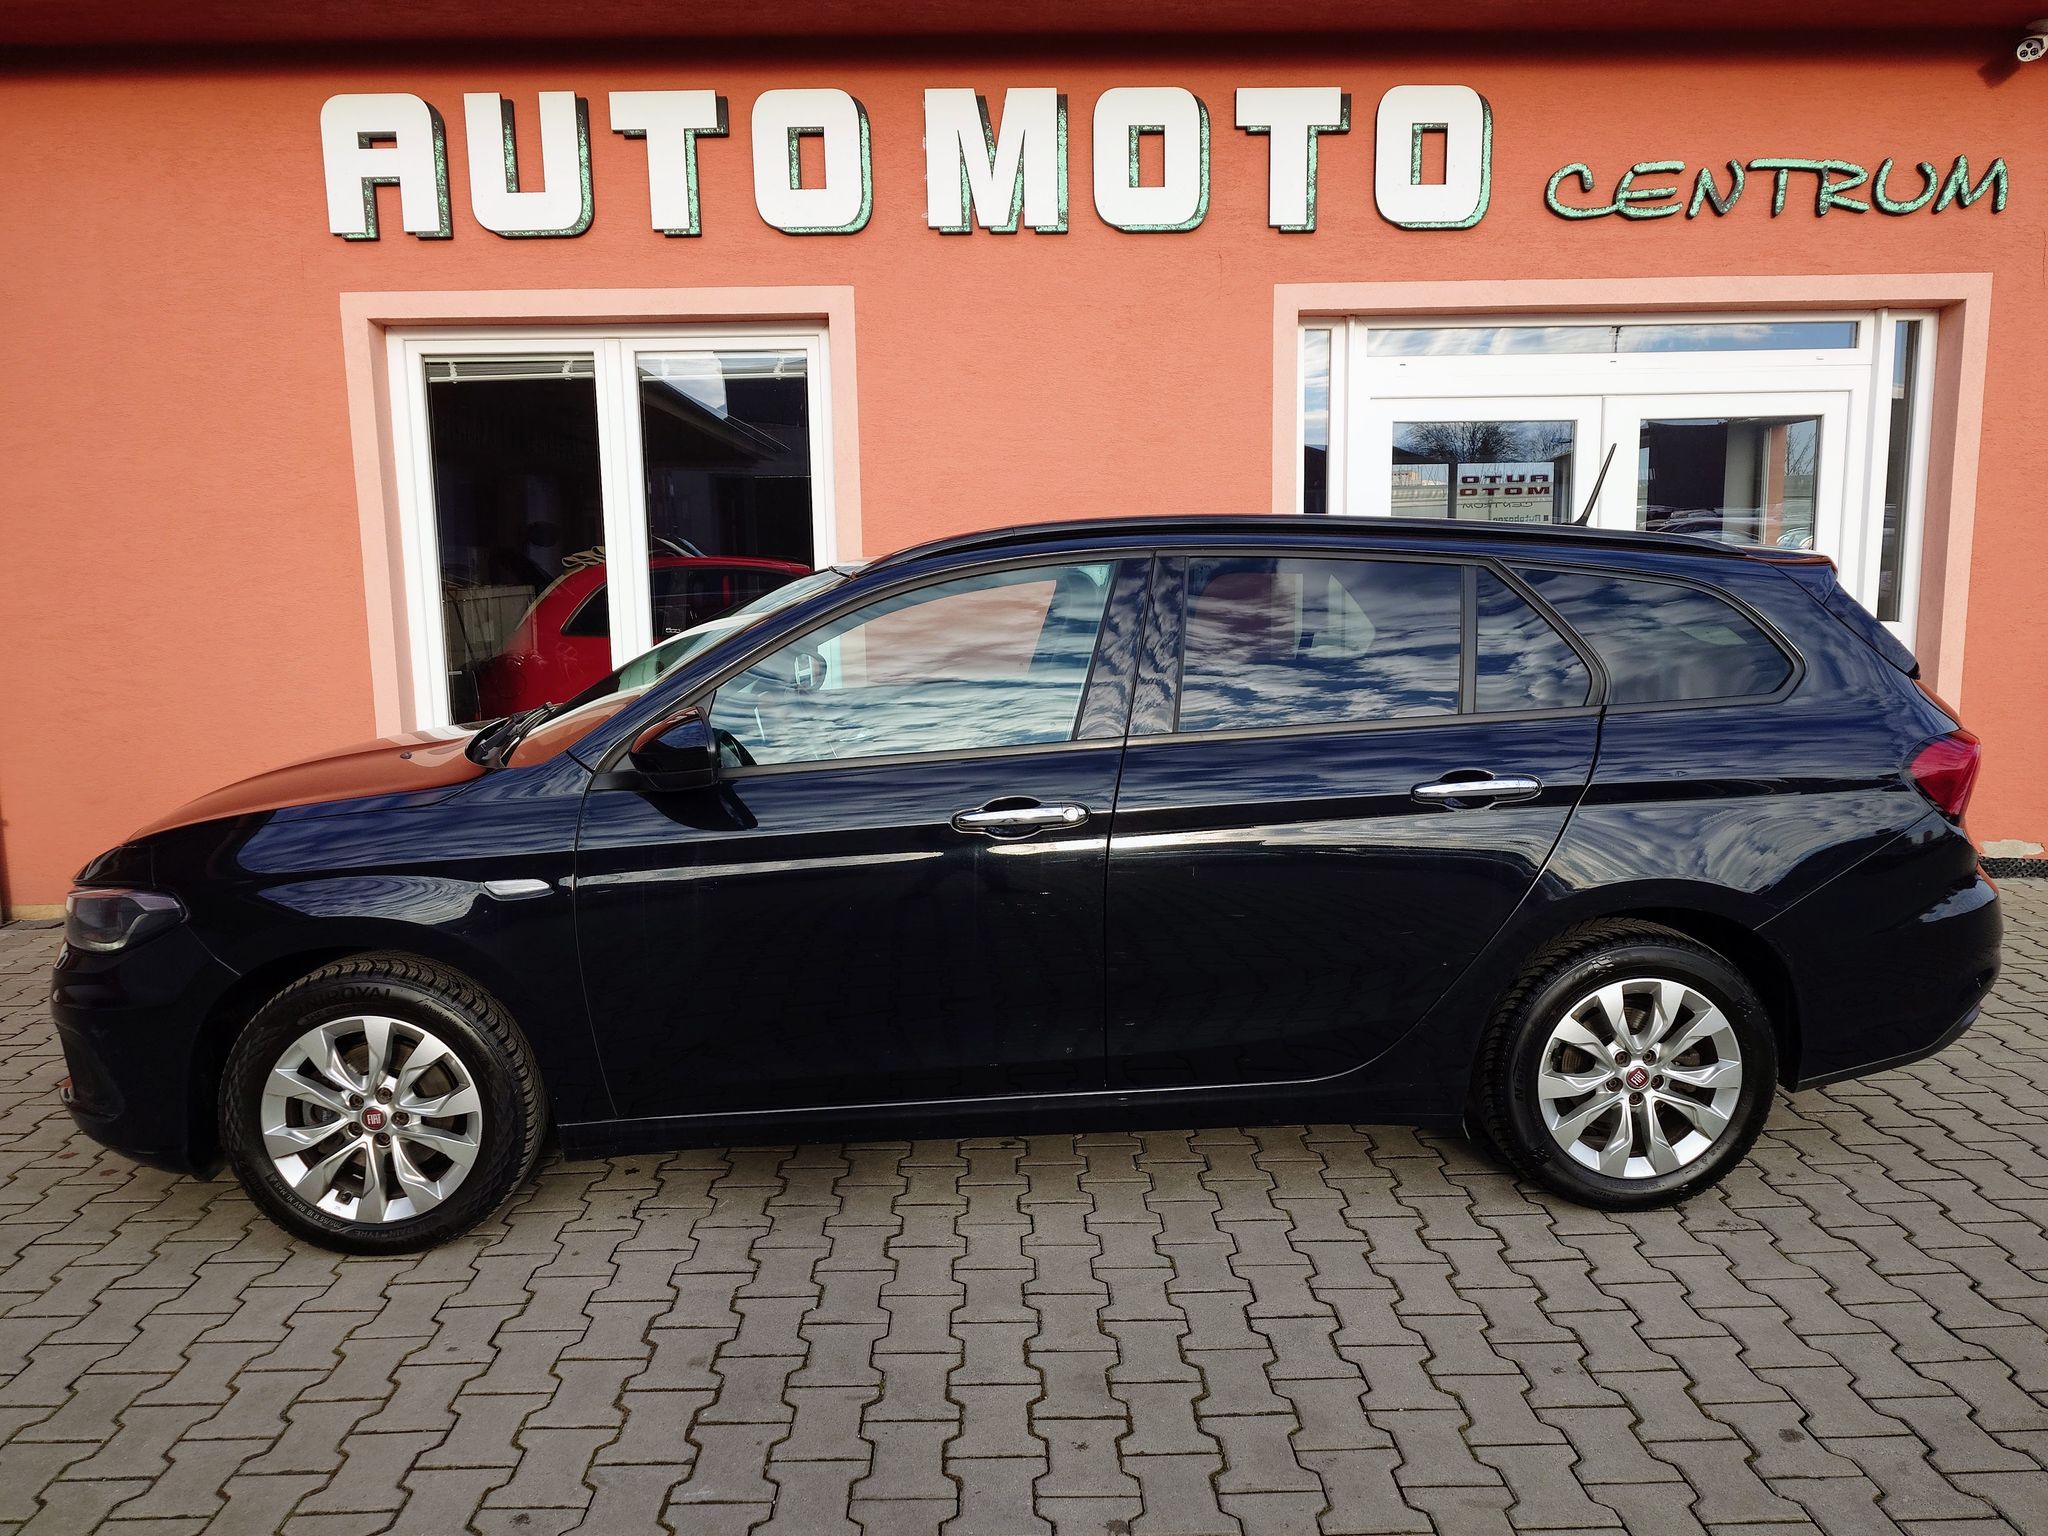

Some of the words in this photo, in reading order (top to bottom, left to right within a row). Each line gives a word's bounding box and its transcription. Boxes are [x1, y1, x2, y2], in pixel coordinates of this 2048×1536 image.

[320, 88, 873, 239] AUTO
[924, 85, 1493, 234] MOTO
[1545, 155, 2009, 220] CENTRUM
[1630, 1070, 1646, 1085] FIAT
[367, 1113, 381, 1125] FIAT
